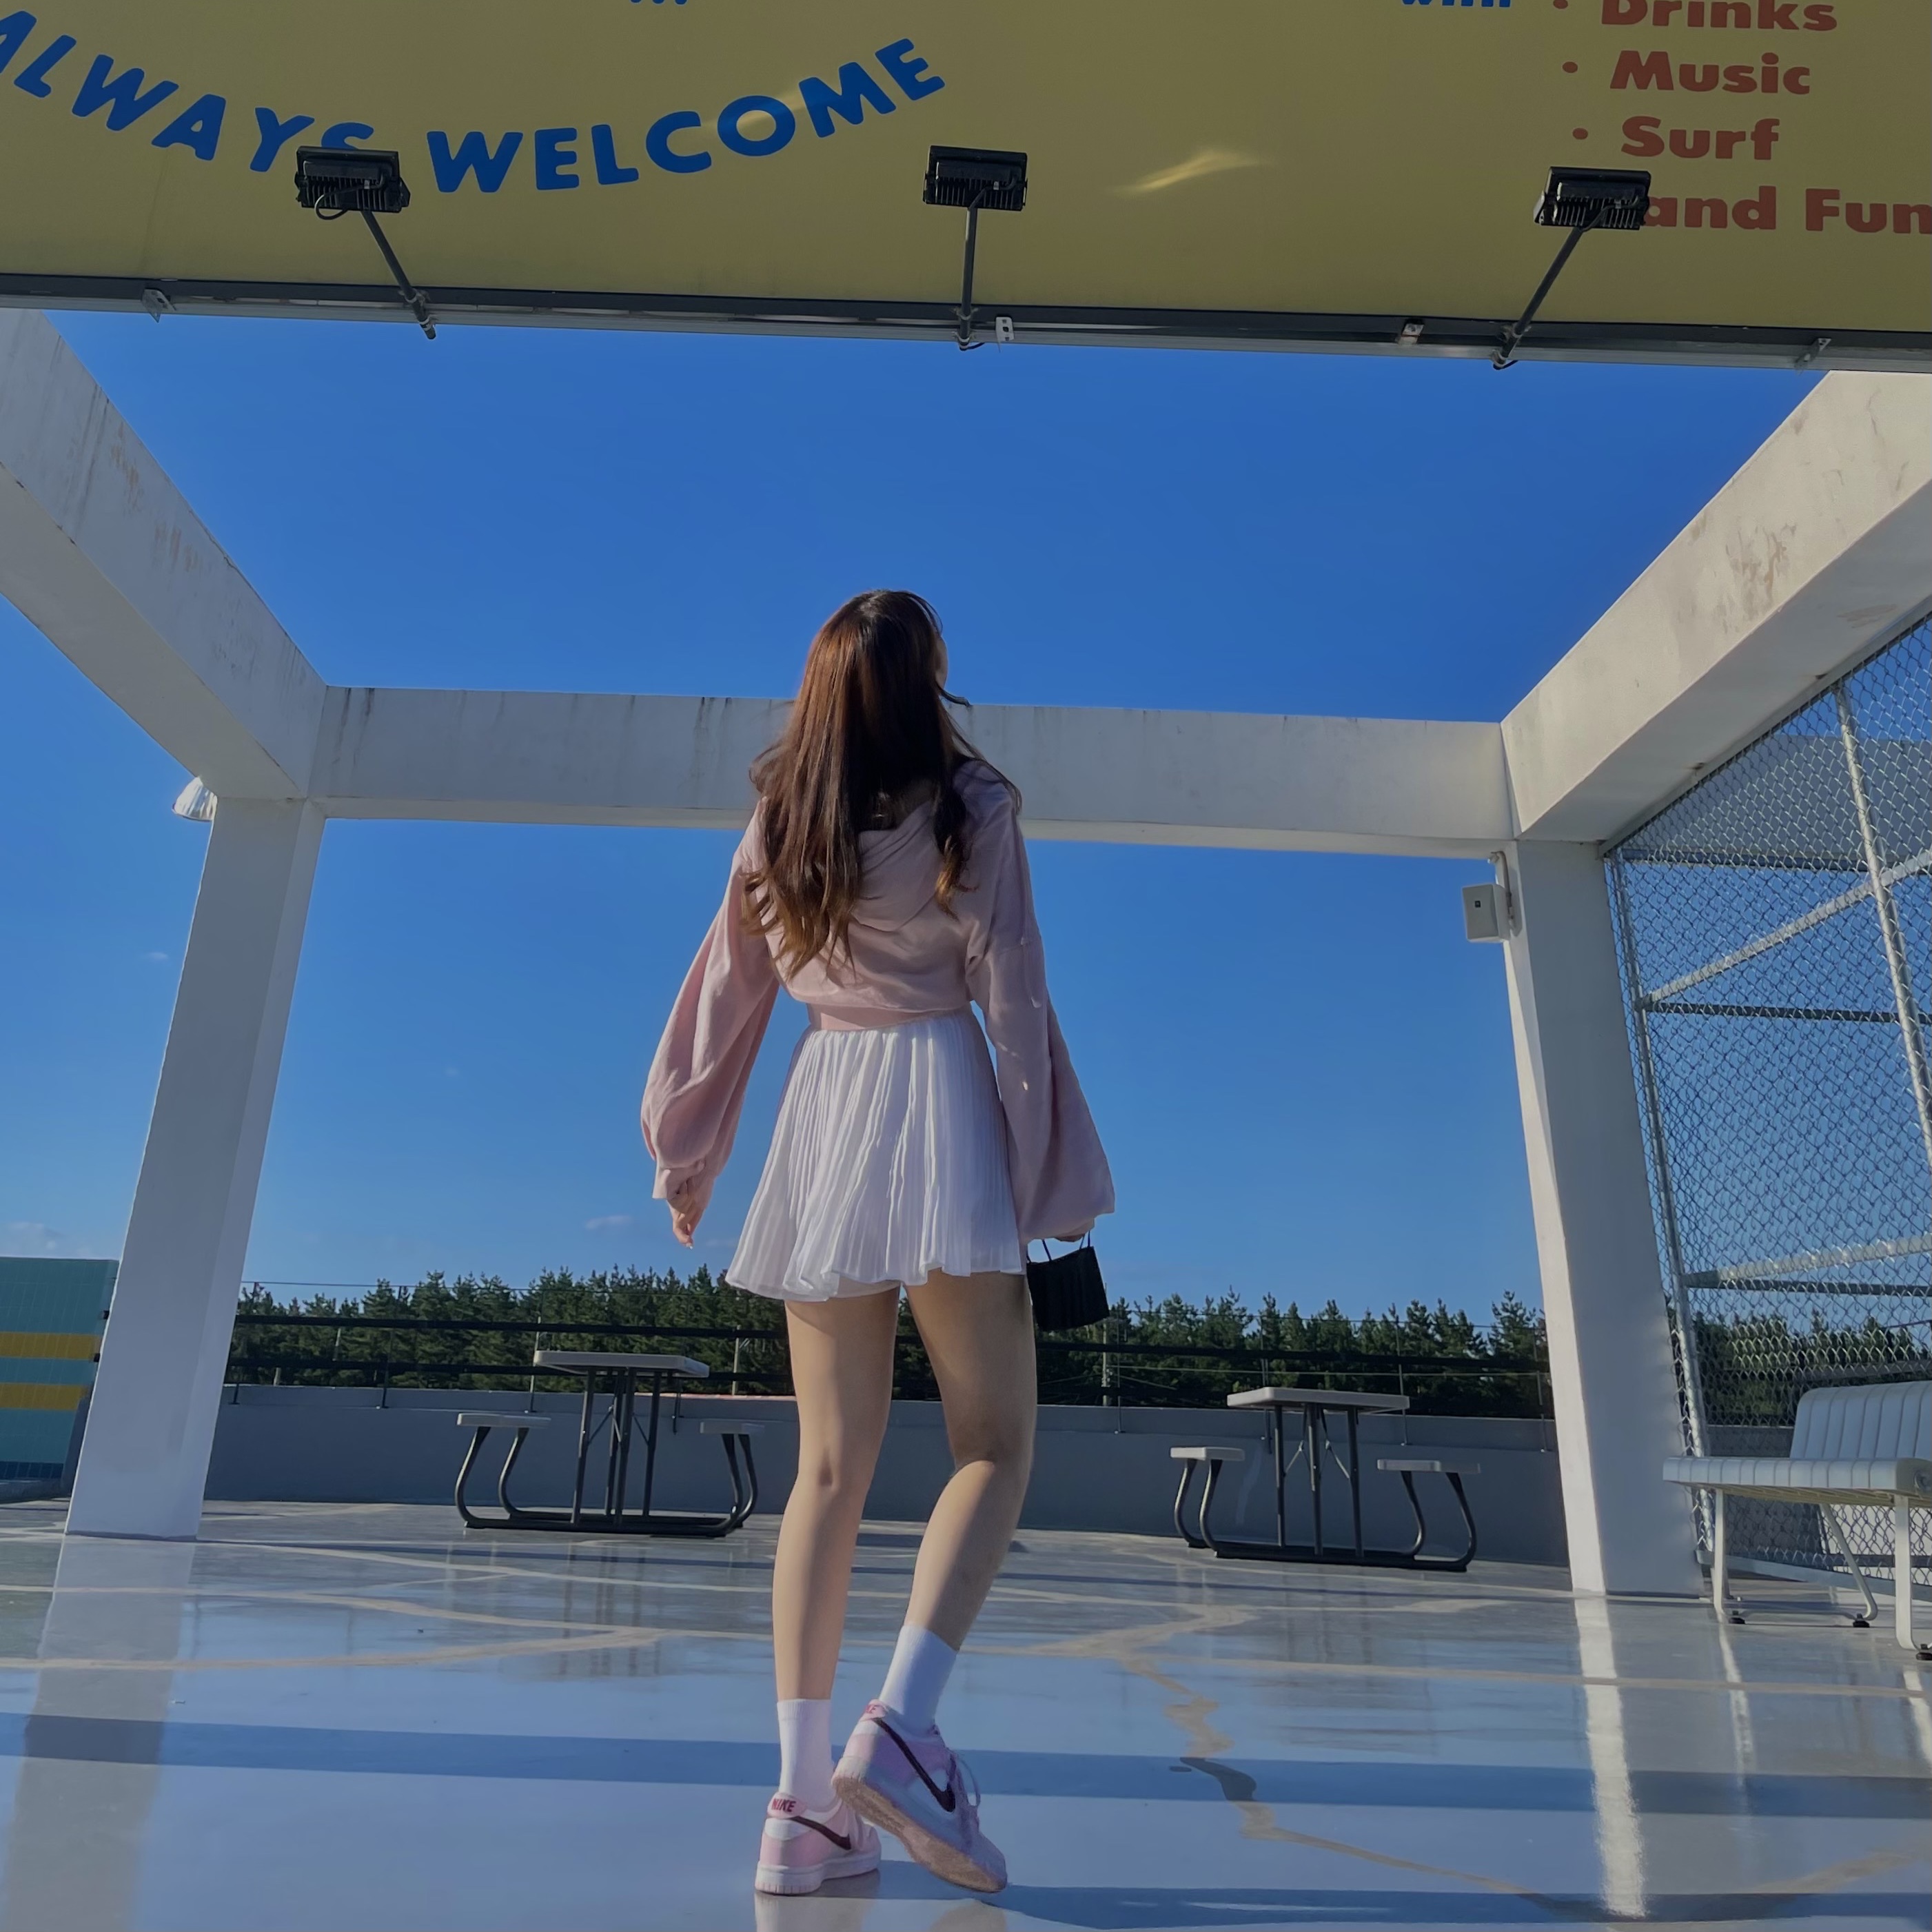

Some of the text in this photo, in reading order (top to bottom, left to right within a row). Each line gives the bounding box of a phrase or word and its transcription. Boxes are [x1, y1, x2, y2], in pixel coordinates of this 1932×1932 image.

[1600, 0, 1838, 32] Drinks
[1609, 50, 1811, 95] Music
[427, 38, 945, 194] WELCOME
[1621, 115, 1780, 161] Surf
[1643, 185, 1932, 234] and Fun
[771, 1798, 797, 1813] NIKE
